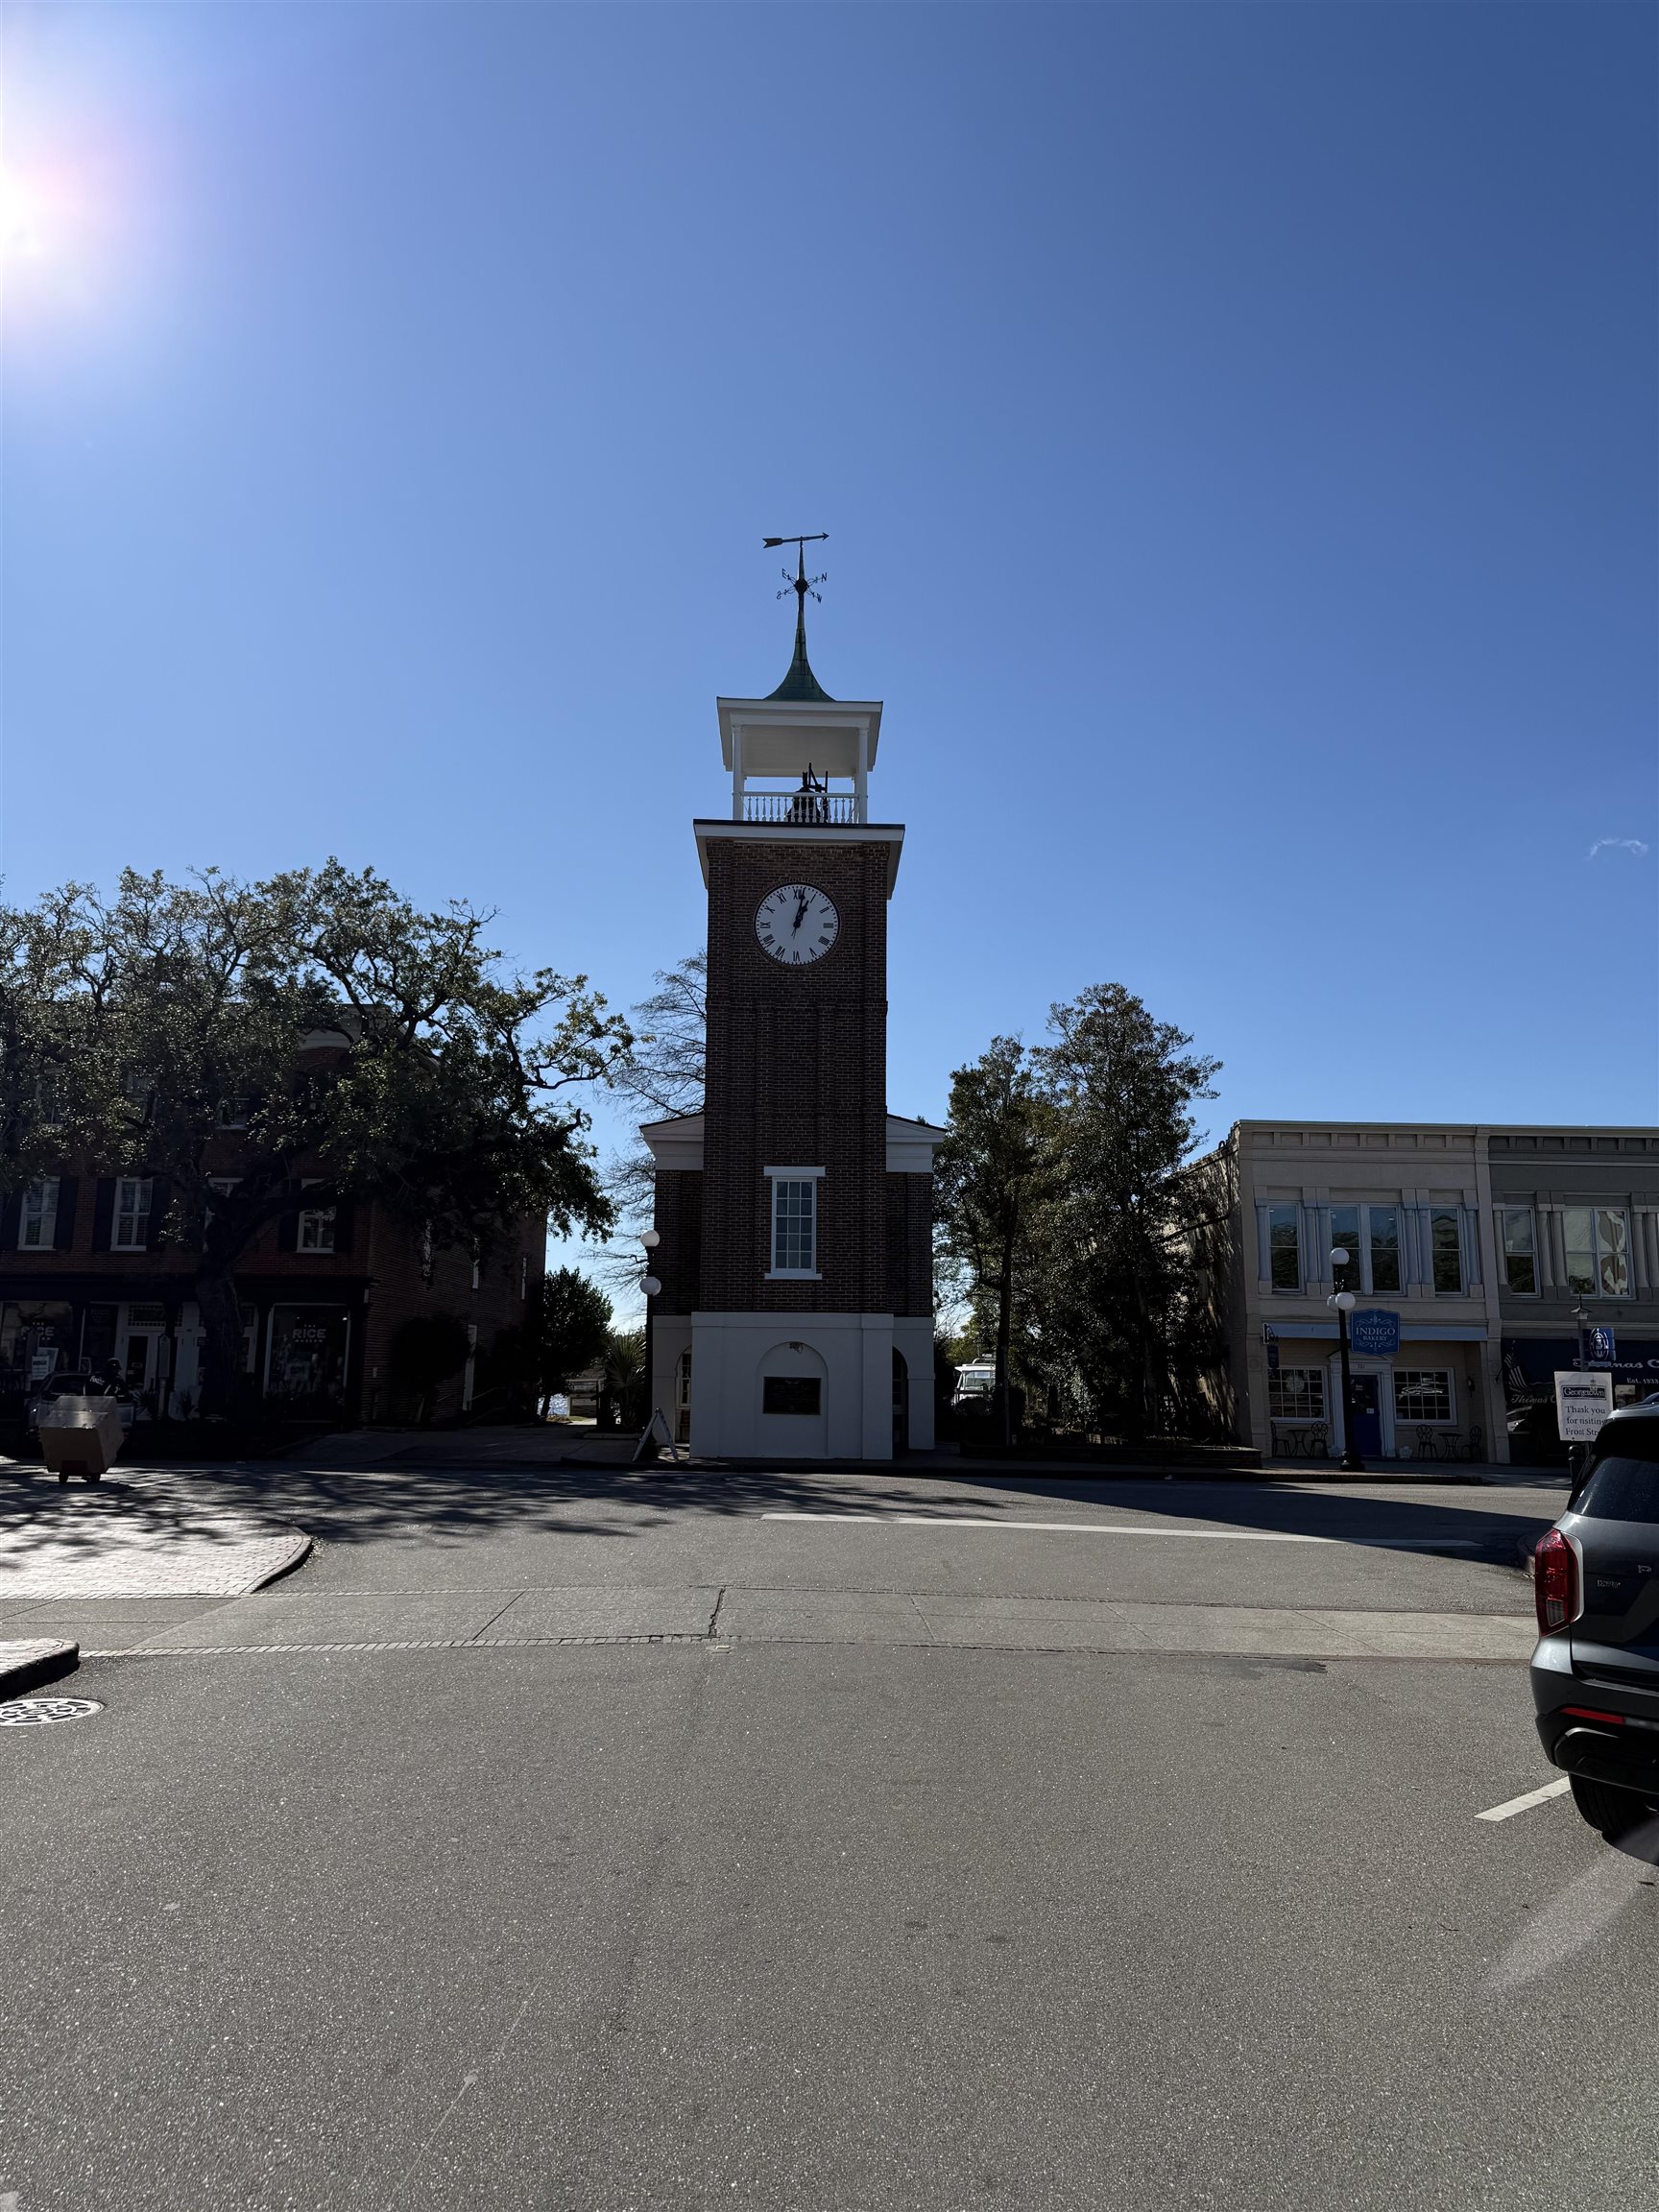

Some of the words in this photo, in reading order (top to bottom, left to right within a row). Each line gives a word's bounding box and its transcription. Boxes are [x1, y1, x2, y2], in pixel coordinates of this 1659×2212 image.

[764, 905, 776, 915] X
[292, 1329, 327, 1338] RICE
[1355, 1327, 1396, 1335] INDIGO
[1563, 1387, 1604, 1397] Georgetown
[1565, 1406, 1590, 1414] Thank
